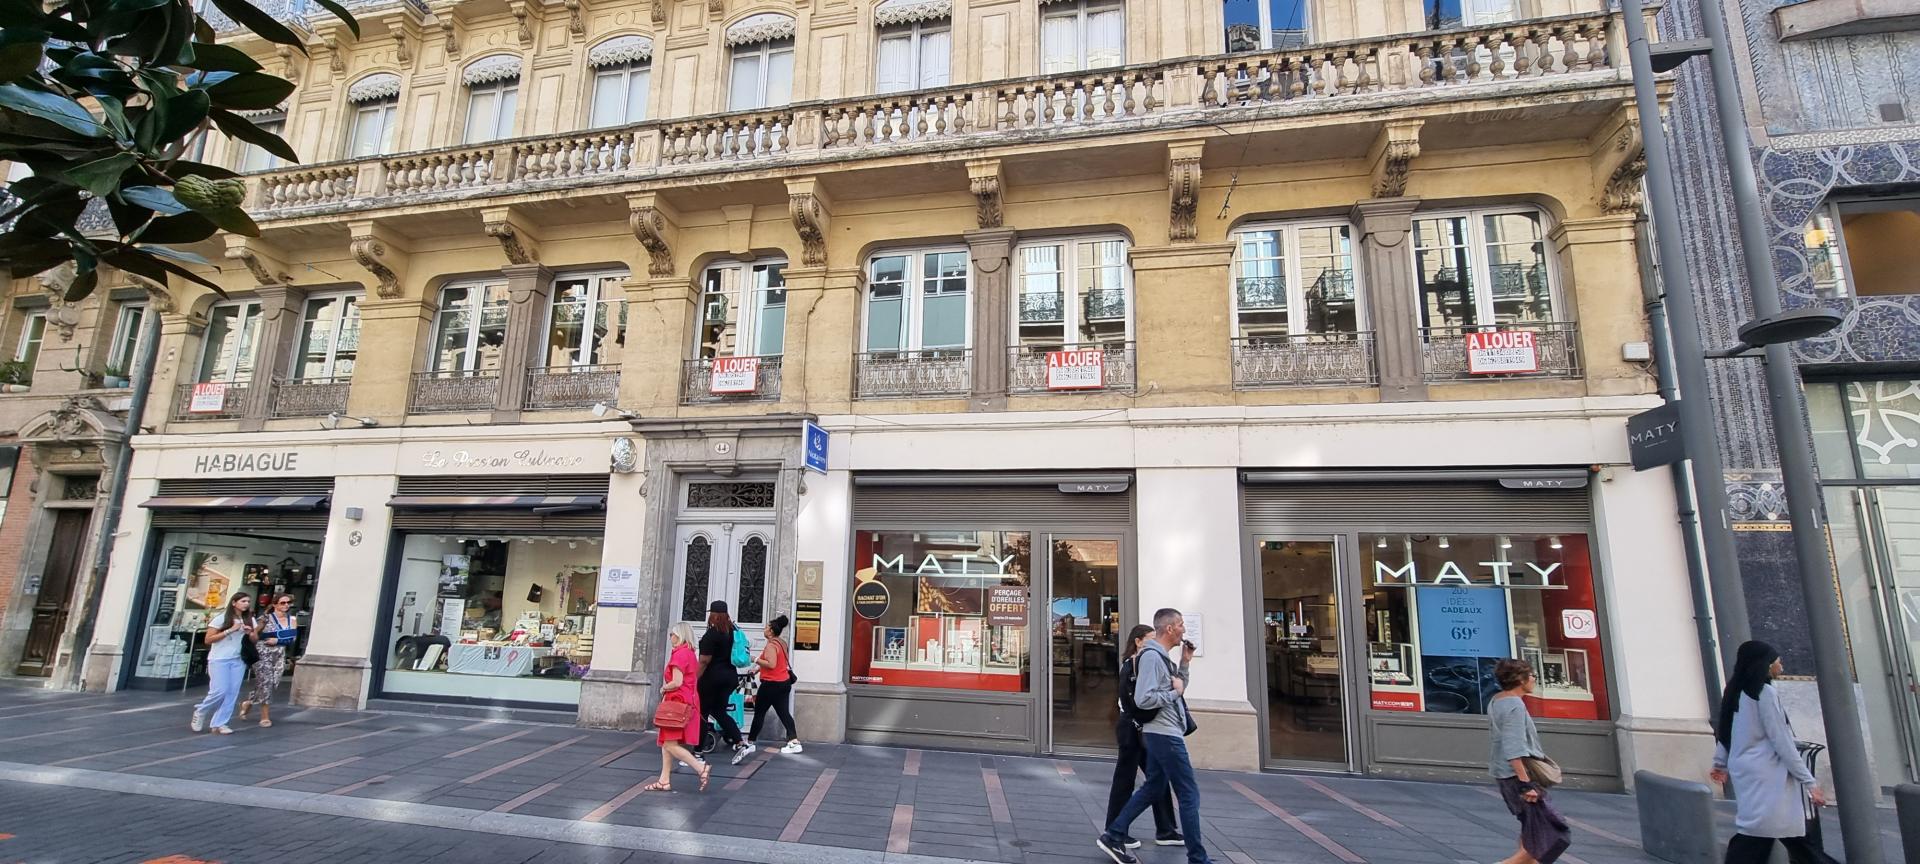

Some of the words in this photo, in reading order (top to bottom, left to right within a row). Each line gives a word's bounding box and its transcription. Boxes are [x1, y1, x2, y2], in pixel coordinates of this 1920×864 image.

[1469, 334, 1481, 349] A
[1484, 332, 1533, 348] LOUER
[714, 360, 721, 372] A
[724, 358, 757, 372] LOUER
[1049, 354, 1058, 367] A
[1062, 352, 1101, 366] LOUER
[194, 384, 200, 395] A
[201, 383, 225, 395] LOUER
[1630, 421, 1676, 445] MATY
[717, 444, 727, 452] 44
[195, 452, 299, 473] HABIAGUE
[422, 450, 447, 468] La
[873, 553, 1015, 575] MATY
[1375, 560, 1562, 586] MATY
[994, 589, 1022, 597] PERÇAGE
[1441, 606, 1482, 614] CADEAUX
[1451, 626, 1480, 640] 69€
